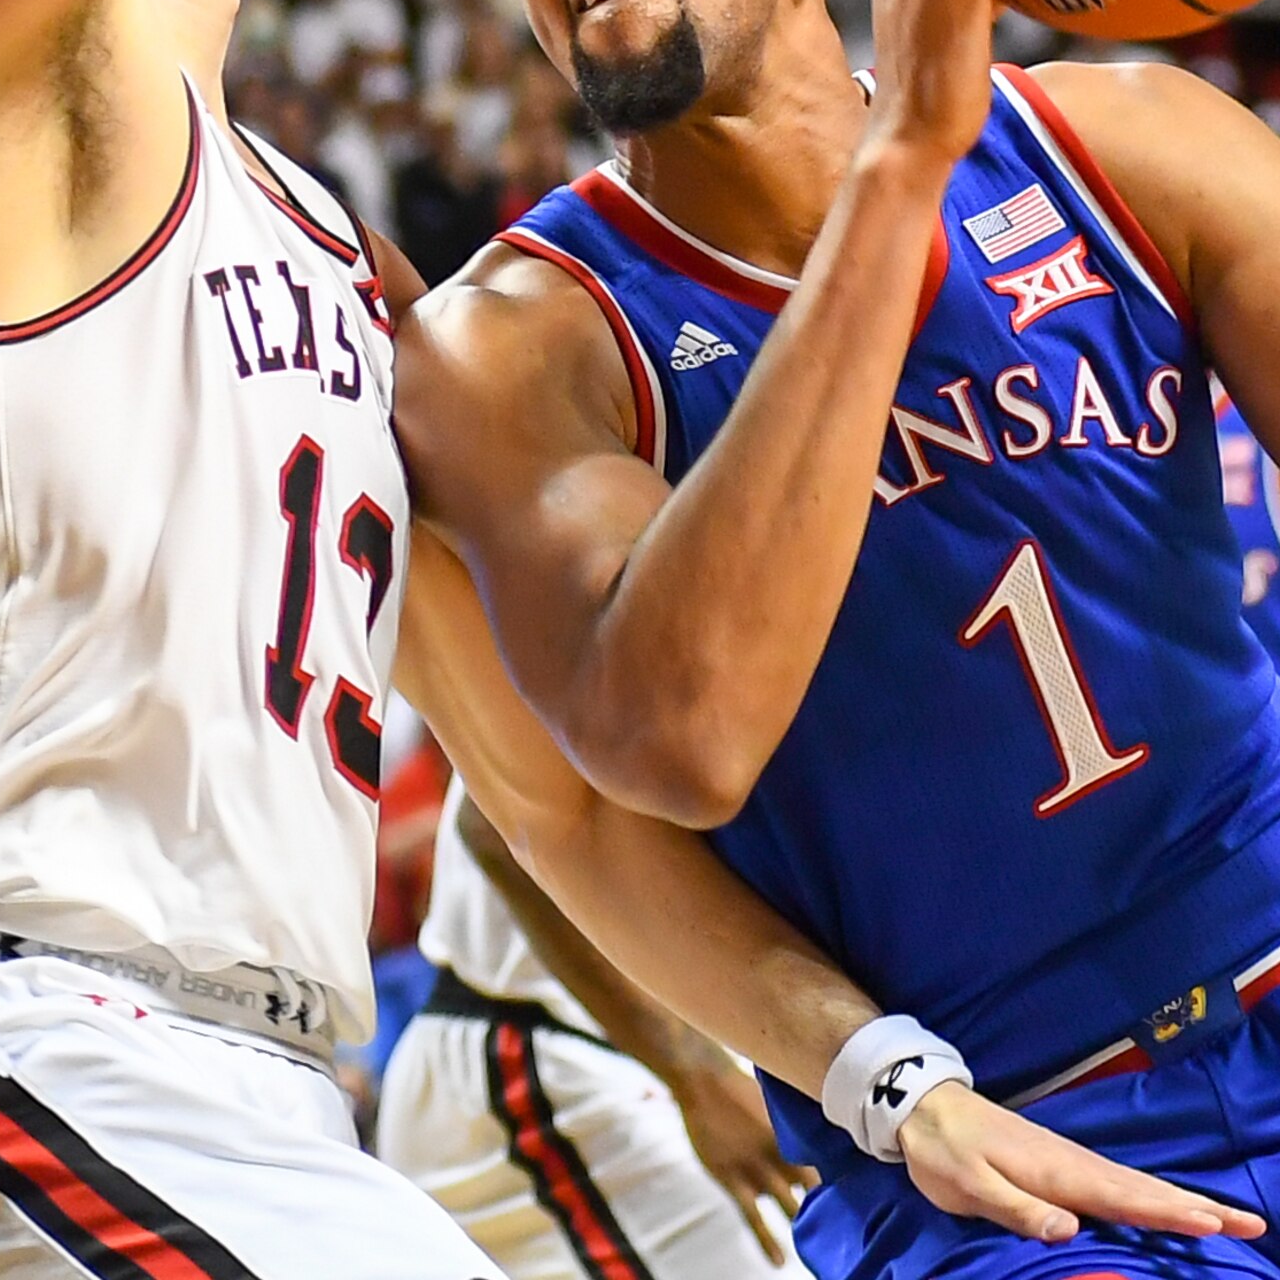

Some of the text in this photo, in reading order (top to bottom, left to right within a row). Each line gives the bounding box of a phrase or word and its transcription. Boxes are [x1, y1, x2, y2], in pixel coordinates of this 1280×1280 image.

[670, 340, 739, 371] adidas
[872, 355, 1183, 507] NSAS
[265, 433, 394, 803] 13
[957, 537, 1150, 819] 1
[178, 970, 257, 1009] UNDER
